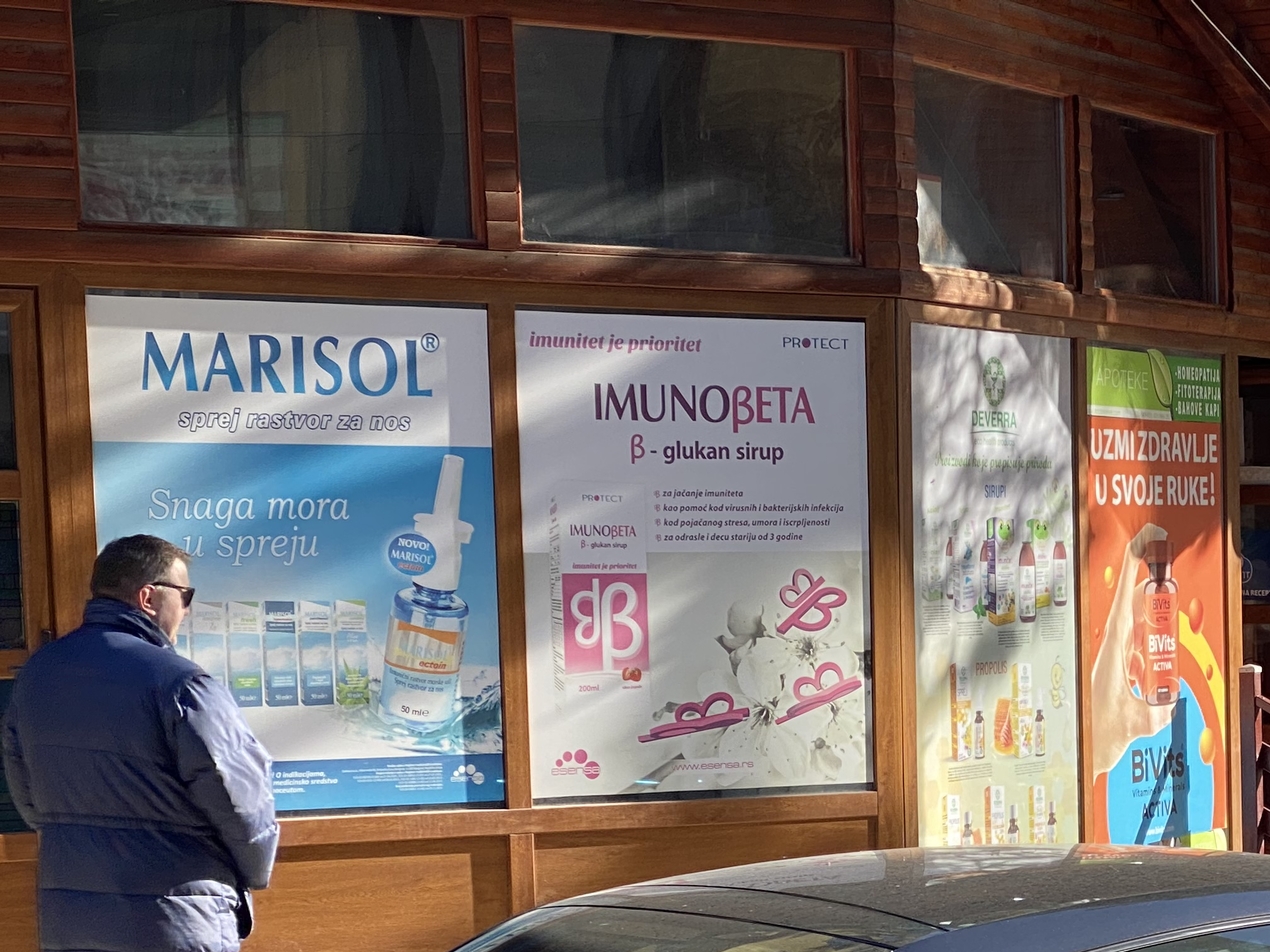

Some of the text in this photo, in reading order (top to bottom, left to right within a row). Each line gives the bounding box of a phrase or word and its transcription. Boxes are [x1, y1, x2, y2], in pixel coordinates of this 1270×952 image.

[528, 331, 702, 354] imunitet je prioritet
[782, 336, 849, 350] PROTECT
[1096, 367, 1149, 391] APOTEKE
[1204, 402, 1220, 417] KAPI
[178, 408, 411, 432] sprej rastvor za nos
[972, 410, 1017, 428] DEVERRA
[1090, 428, 1217, 463] UZMI ZDRAVLJE
[662, 441, 730, 468] glukan
[735, 441, 785, 465] sirup
[662, 489, 744, 499] za jačanje imuniteta
[984, 484, 1007, 499] SIRUPI
[1095, 472, 1216, 506] U SVOJE RUKE!
[148, 488, 349, 529] Snaga mora
[662, 504, 679, 512] kao
[679, 503, 708, 515] pomoć
[708, 503, 724, 512] kod
[724, 504, 757, 512] virusnih
[762, 503, 810, 514] bakterijskih
[810, 504, 844, 513] infekcija
[663, 518, 679, 527] kod
[679, 518, 723, 528] pojačanog
[724, 519, 750, 527] stresa,
[782, 518, 831, 528] iscrpljenosti
[397, 538, 430, 551] NOVO!
[590, 541, 611, 550] glukan
[612, 542, 628, 550] sirup
[663, 534, 674, 542] za
[674, 533, 705, 542] odrasle
[710, 533, 729, 542] decu
[730, 533, 757, 543] stariju
[757, 533, 769, 542] od
[775, 533, 803, 543] godine
[182, 525, 320, 567] u spreju
[1148, 634, 1176, 653] BiVits
[975, 660, 1008, 676] PROPOLIS
[1153, 661, 1173, 671] ACTIVA
[401, 705, 411, 714] 50
[671, 760, 755, 772] www.esensa.rs
[1143, 799, 1178, 820] ACTIVA
